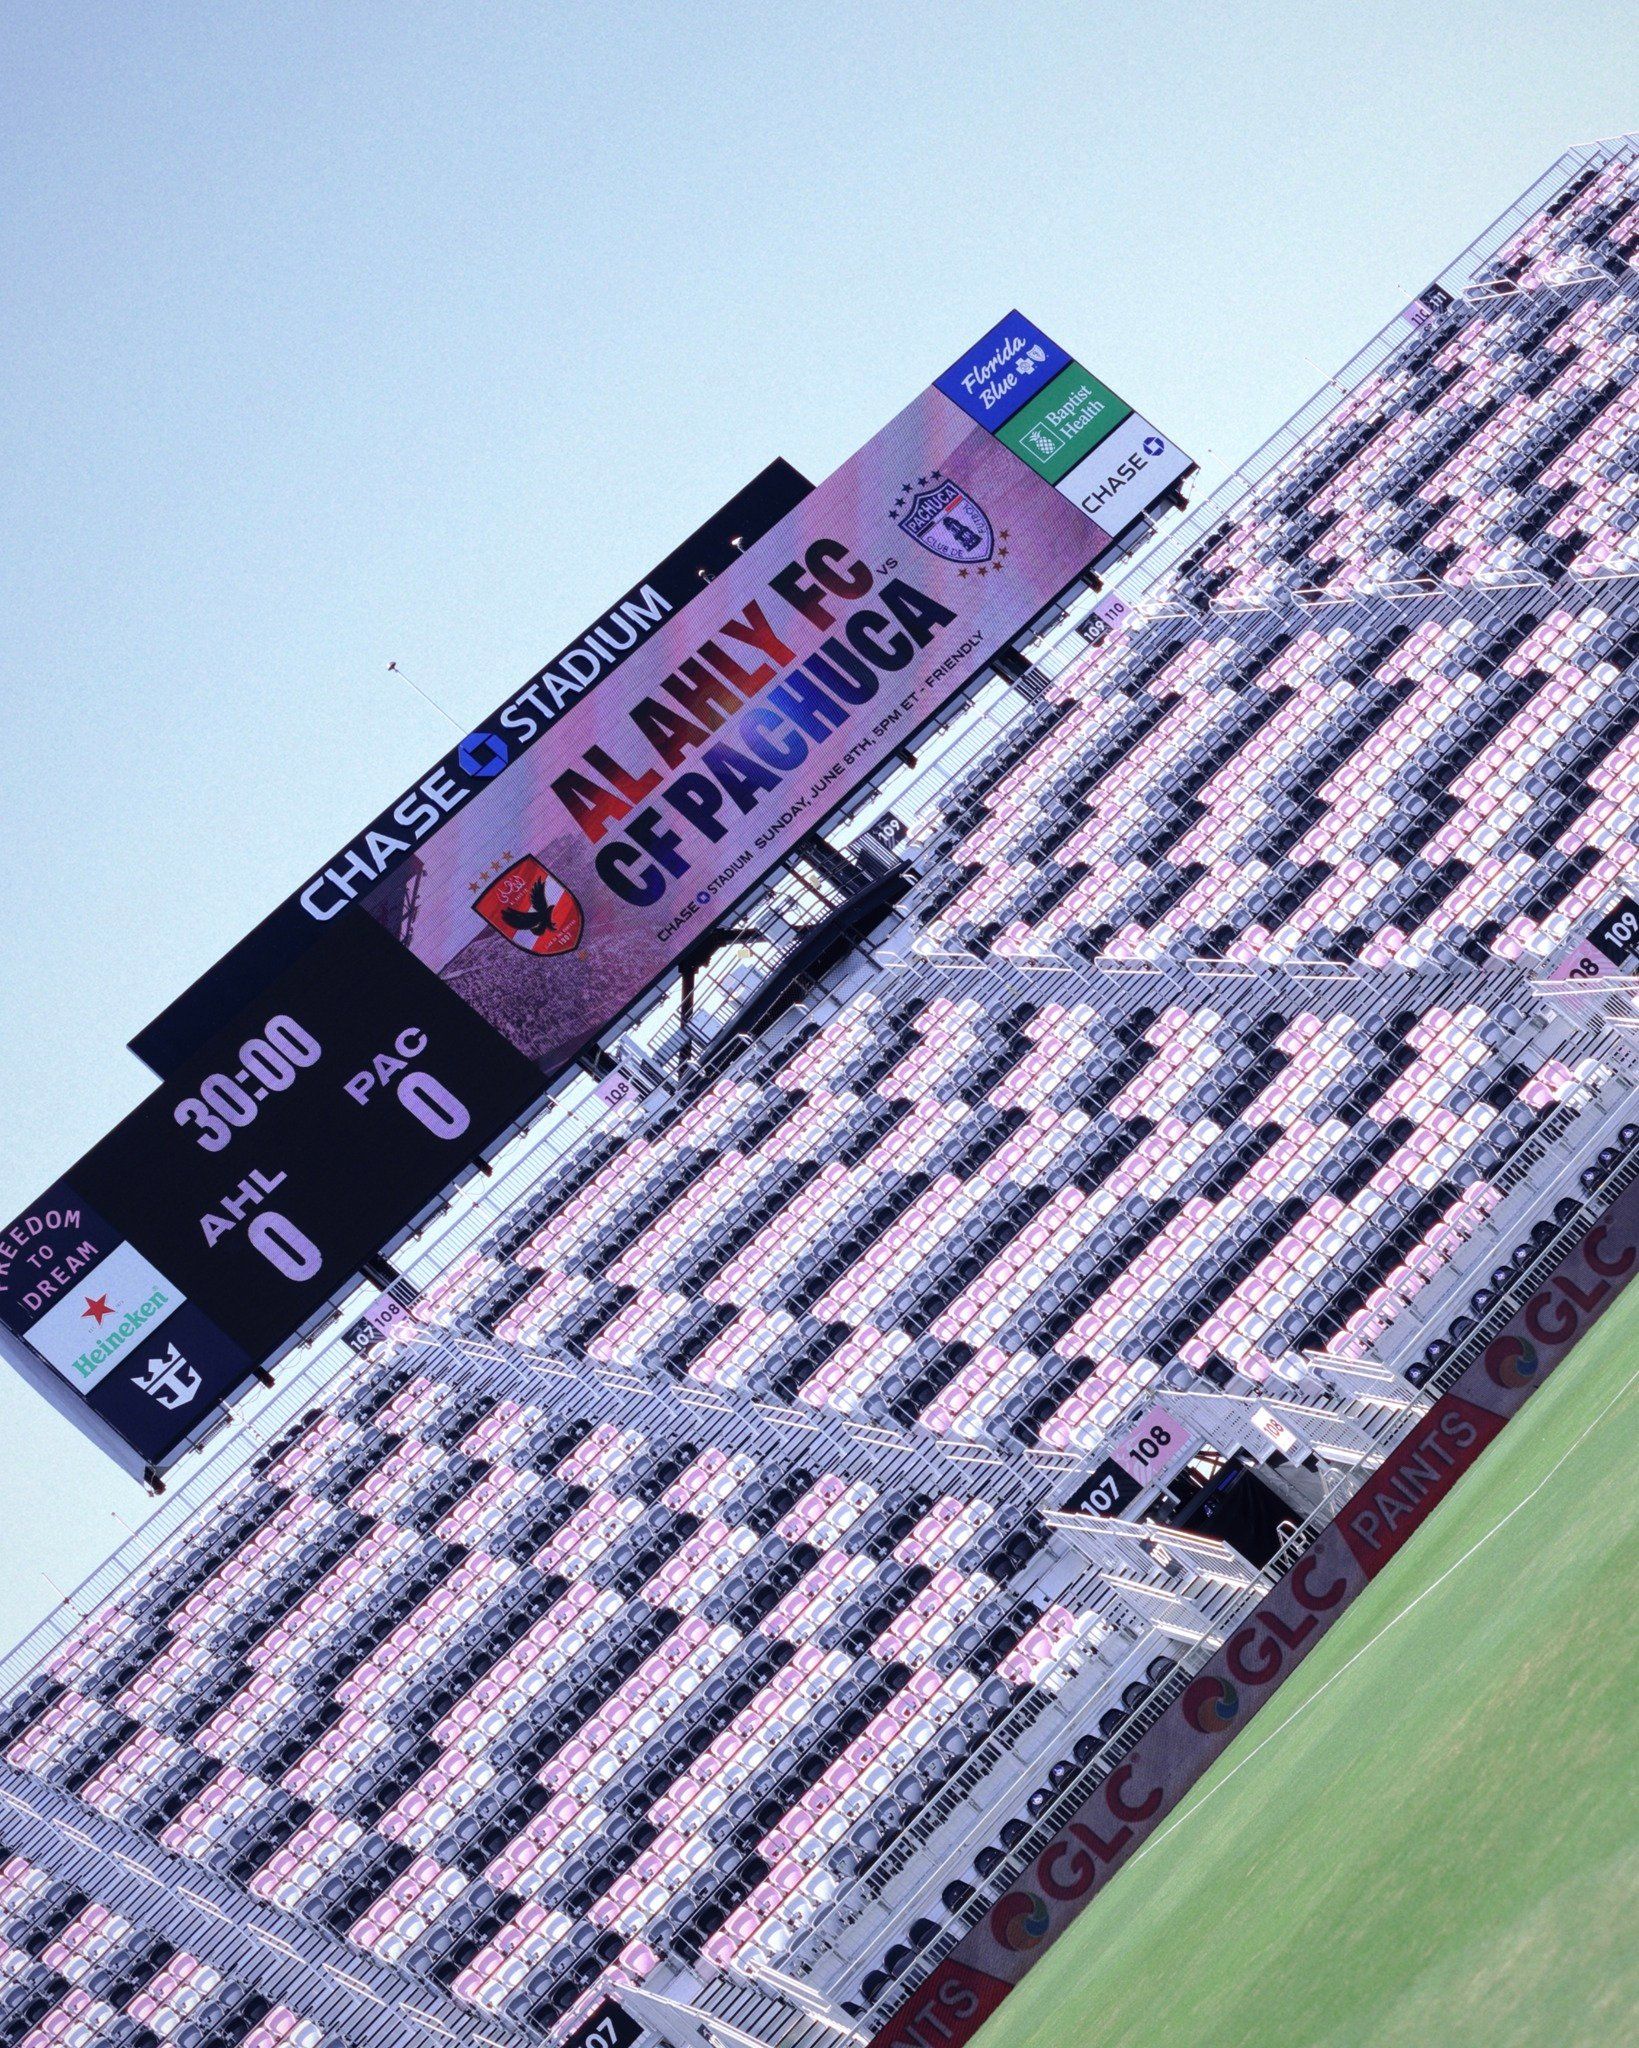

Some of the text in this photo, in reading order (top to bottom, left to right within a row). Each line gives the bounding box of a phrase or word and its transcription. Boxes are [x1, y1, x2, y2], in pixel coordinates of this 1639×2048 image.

[961, 337, 1026, 394] Florida
[979, 374, 1017, 409] Blue
[1046, 385, 1092, 427] Baptist
[1061, 401, 1105, 439] Health
[908, 490, 956, 531] PACHUCA
[1082, 453, 1148, 513] CHASE
[1084, 603, 1124, 641] 109 110
[550, 539, 873, 844] AL AHLY FC
[300, 584, 673, 920] CHASE STADIUM
[594, 578, 957, 907] CF PACHUCA
[656, 901, 700, 942] CHASE
[707, 850, 753, 894] STADIUM
[754, 796, 811, 849] SUNDAY,
[811, 763, 845, 798] JUNE
[843, 738, 876, 765] 8TH,
[872, 709, 902, 737] 5PM
[900, 691, 919, 711] ET
[925, 630, 983, 687] FRIENDLY
[878, 819, 901, 841] 109
[1604, 912, 1639, 948] 109
[174, 1015, 321, 1152] 30:00
[343, 1028, 427, 1105] PAC
[605, 1083, 629, 1106] 108
[397, 1072, 470, 1139] 0
[200, 1169, 287, 1247] AHL
[22, 1240, 99, 1311] DREAM
[27, 1246, 53, 1268] TO
[248, 1212, 322, 1281] 0
[1525, 1224, 1637, 1345] GLC
[72, 1292, 168, 1378] Heineken
[350, 1303, 401, 1354] 107 108
[1264, 1418, 1284, 1438] 108
[1081, 1426, 1171, 1515] 107 108
[1150, 1542, 1171, 1566] 107
[1227, 1412, 1477, 1686] GLC PAINTS
[1037, 1762, 1163, 1901] GLC
[578, 2016, 618, 2048] 07
